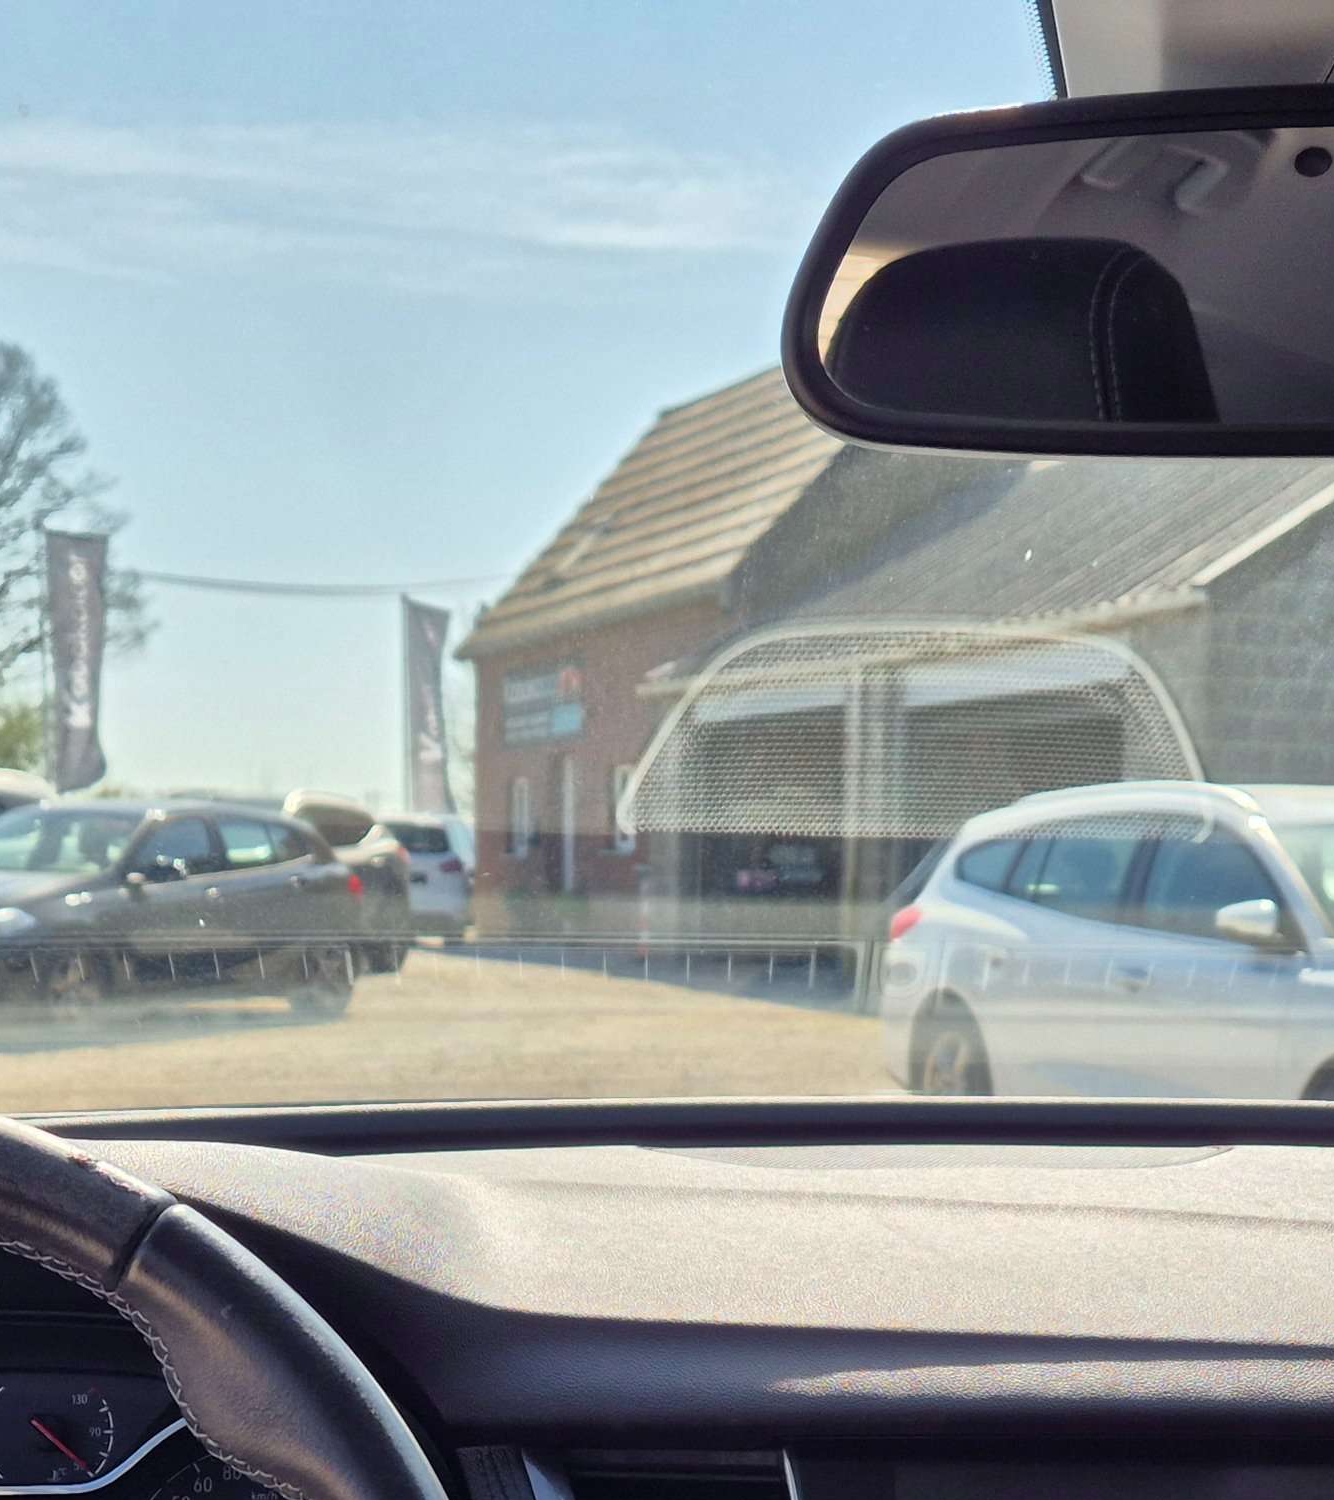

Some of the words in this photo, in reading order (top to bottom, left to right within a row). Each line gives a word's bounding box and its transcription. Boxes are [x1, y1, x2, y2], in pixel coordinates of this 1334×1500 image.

[71, 1394, 89, 1405] 130
[89, 1427, 102, 1437] 90
[193, 1477, 213, 1493] 60
